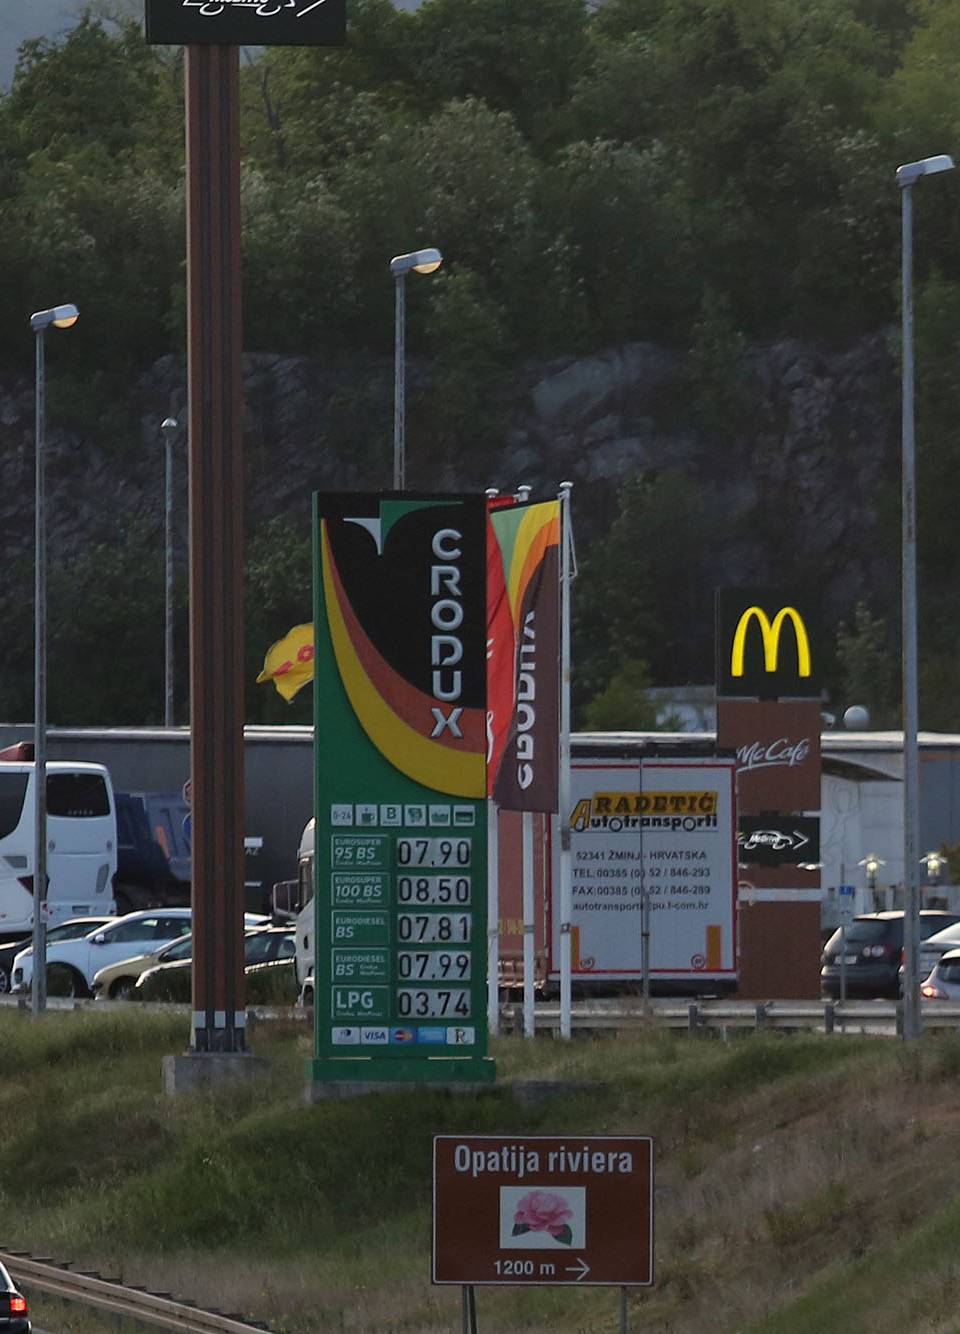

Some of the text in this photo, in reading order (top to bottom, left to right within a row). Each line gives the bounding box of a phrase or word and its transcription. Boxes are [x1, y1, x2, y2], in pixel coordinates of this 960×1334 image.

[430, 528, 464, 737] CRODUX
[335, 847, 375, 859] 95 BS
[576, 851, 605, 861] 52341
[650, 851, 706, 860] HRVATSKA
[336, 885, 382, 897] 100 BS
[335, 927, 354, 938] BS
[335, 964, 354, 976] BS
[336, 992, 373, 1008] LPG
[365, 1032, 386, 1040] VISA
[454, 1145, 633, 1178] Opatija riviera
[494, 1260, 556, 1275] 1200 m
